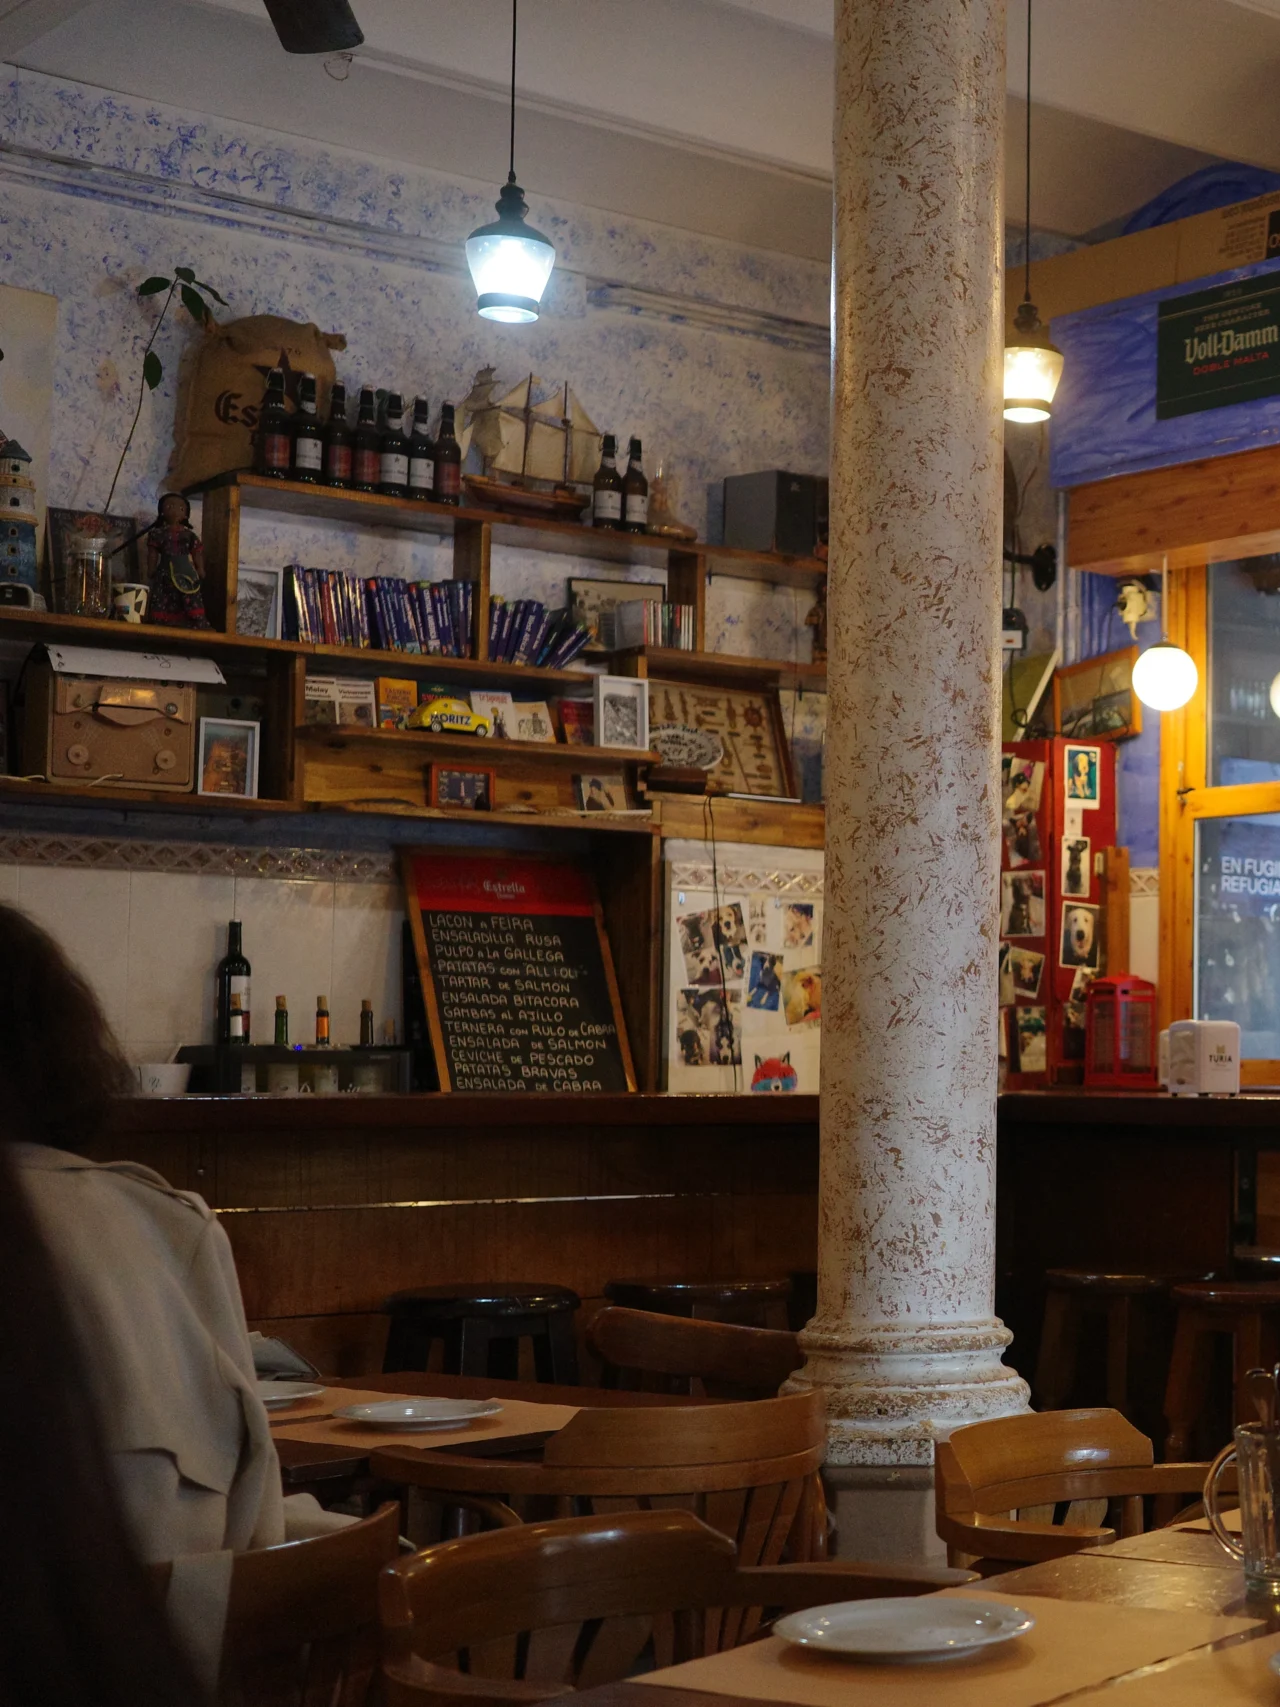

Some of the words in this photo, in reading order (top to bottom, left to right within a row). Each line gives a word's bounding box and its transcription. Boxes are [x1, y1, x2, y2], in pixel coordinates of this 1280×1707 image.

[1218, 308, 1271, 328] CHARACTER
[1184, 324, 1279, 364] Voll-Damm
[1193, 359, 1230, 376] DOBLE
[1233, 351, 1270, 366] MALTA
[305, 686, 329, 694] Malay
[430, 713, 471, 725] MORITZ
[1221, 856, 1242, 874] EN
[483, 879, 526, 893] Estrella
[429, 913, 473, 928] LACON
[490, 915, 534, 931] FEIRA
[432, 928, 515, 944] ENSALADILLA
[525, 933, 562, 947] RUSA
[435, 944, 474, 957] PULPO
[504, 947, 565, 962] GALLEGA
[437, 958, 495, 974] PATATAS
[439, 974, 491, 990] TARTAR
[514, 979, 571, 993] SALMON
[442, 991, 508, 1006] ENSALADA
[513, 993, 580, 1008] BITACORA
[443, 1005, 496, 1020] GAMBAS
[518, 1008, 563, 1023] AJILLO
[444, 1020, 505, 1035] TERNERA
[531, 1024, 566, 1037] RULO
[580, 1020, 616, 1036] CABRA
[449, 1035, 520, 1050] ENSALADA
[547, 1038, 607, 1050] SALMON
[451, 1049, 504, 1063] CEVICHE
[529, 1052, 594, 1066] PESCADO
[1209, 1054, 1233, 1063] TURIA
[454, 1062, 512, 1077] PATATAS
[521, 1065, 578, 1079] BRAVAS
[456, 1077, 526, 1091] ENSALADA
[553, 1079, 602, 1092] CABRA
